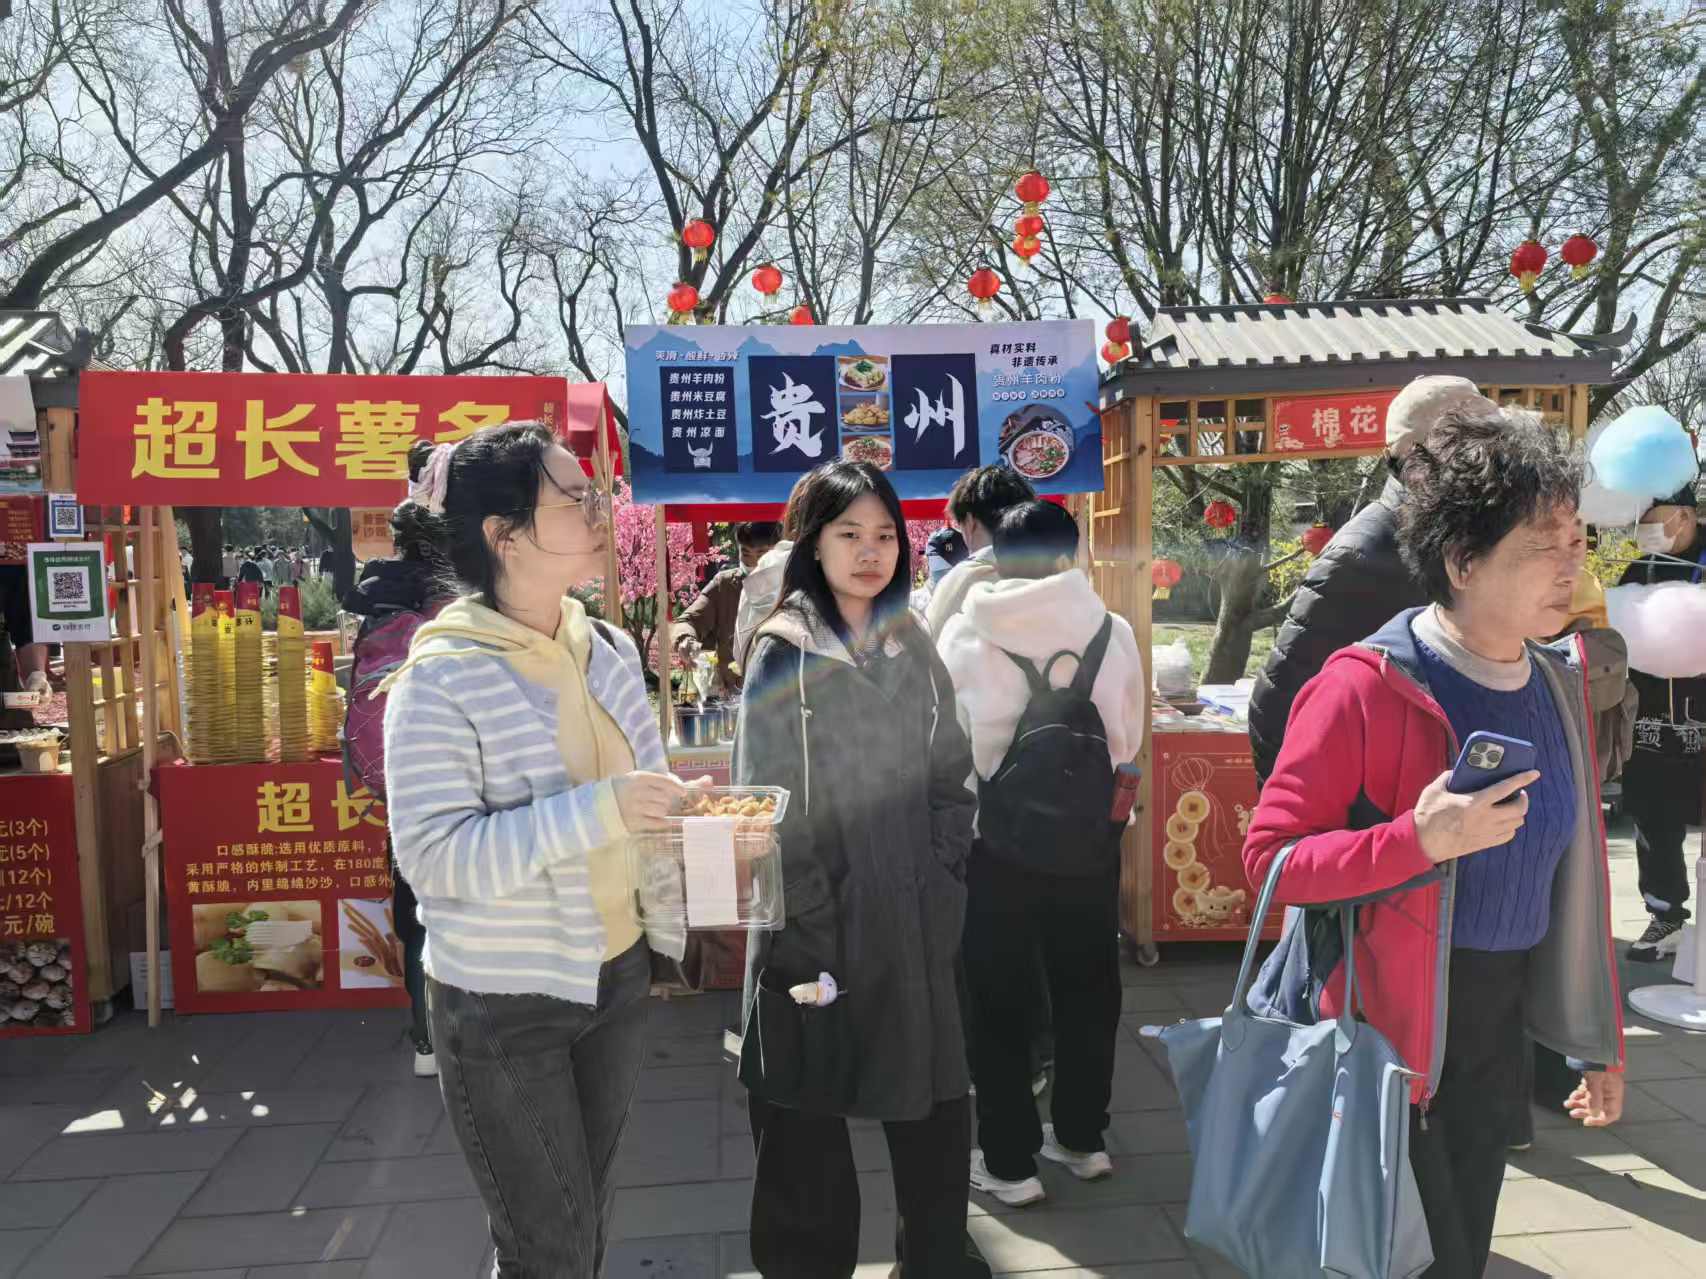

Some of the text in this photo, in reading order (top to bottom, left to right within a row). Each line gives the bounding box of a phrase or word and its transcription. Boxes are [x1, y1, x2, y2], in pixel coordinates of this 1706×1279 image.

[990, 342, 1037, 355] 真材实料
[1011, 355, 1058, 368] 非遗传承
[668, 372, 725, 385] 贵州羊肉粉
[670, 390, 726, 403] 贵州米豆腐
[671, 408, 727, 421] 贵州炸土豆
[1311, 404, 1379, 438] 棉花
[671, 425, 726, 439] 贵州凉面
[4, 913, 55, 935] 元/碗
